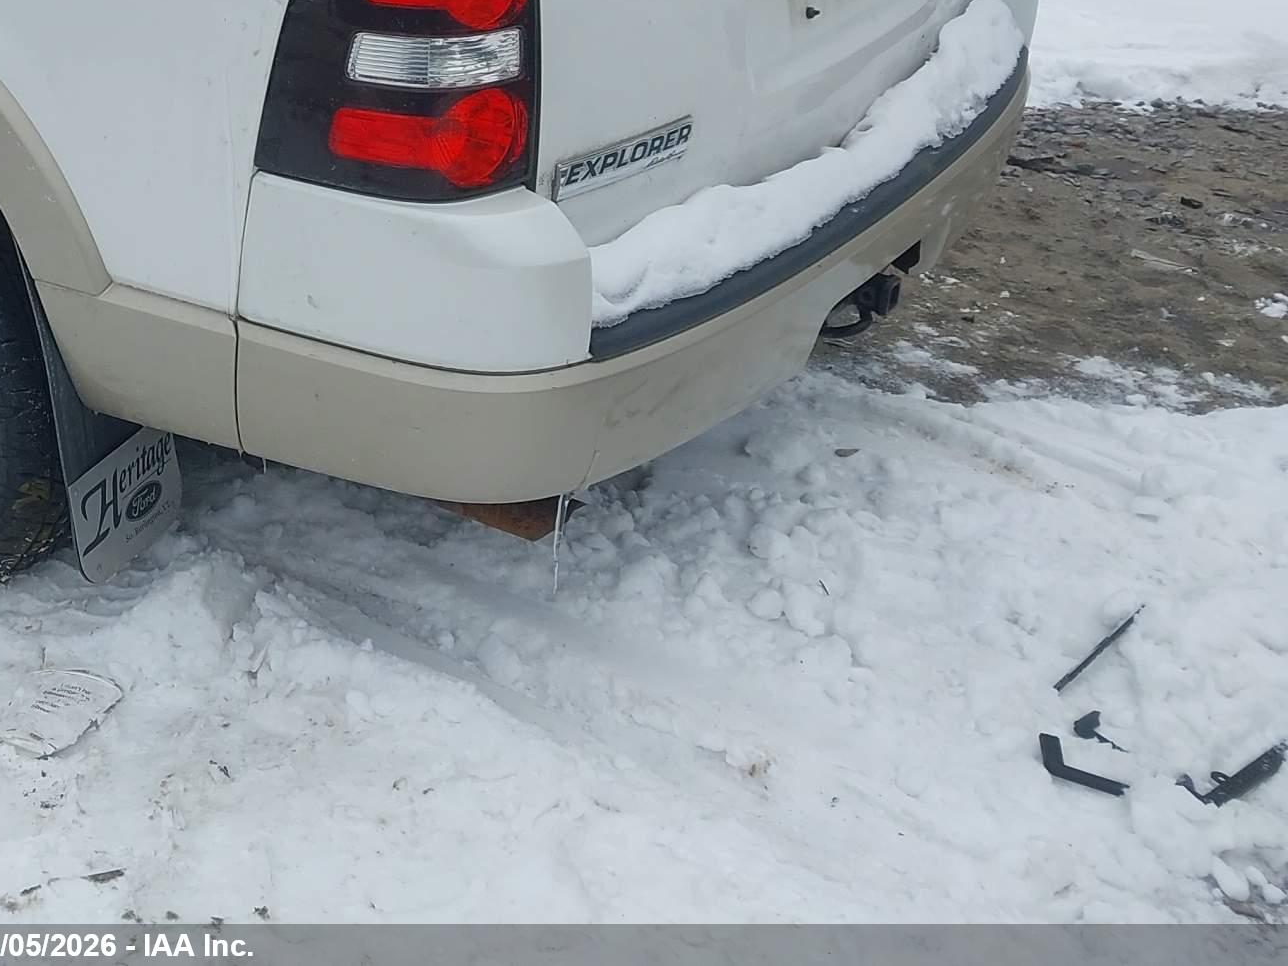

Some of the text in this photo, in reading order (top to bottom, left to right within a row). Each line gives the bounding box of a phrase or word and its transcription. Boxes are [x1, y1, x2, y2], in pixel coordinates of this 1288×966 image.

[564, 123, 693, 187] EXPLORER
[80, 431, 172, 557] Heritage
[130, 486, 157, 517] Ford
